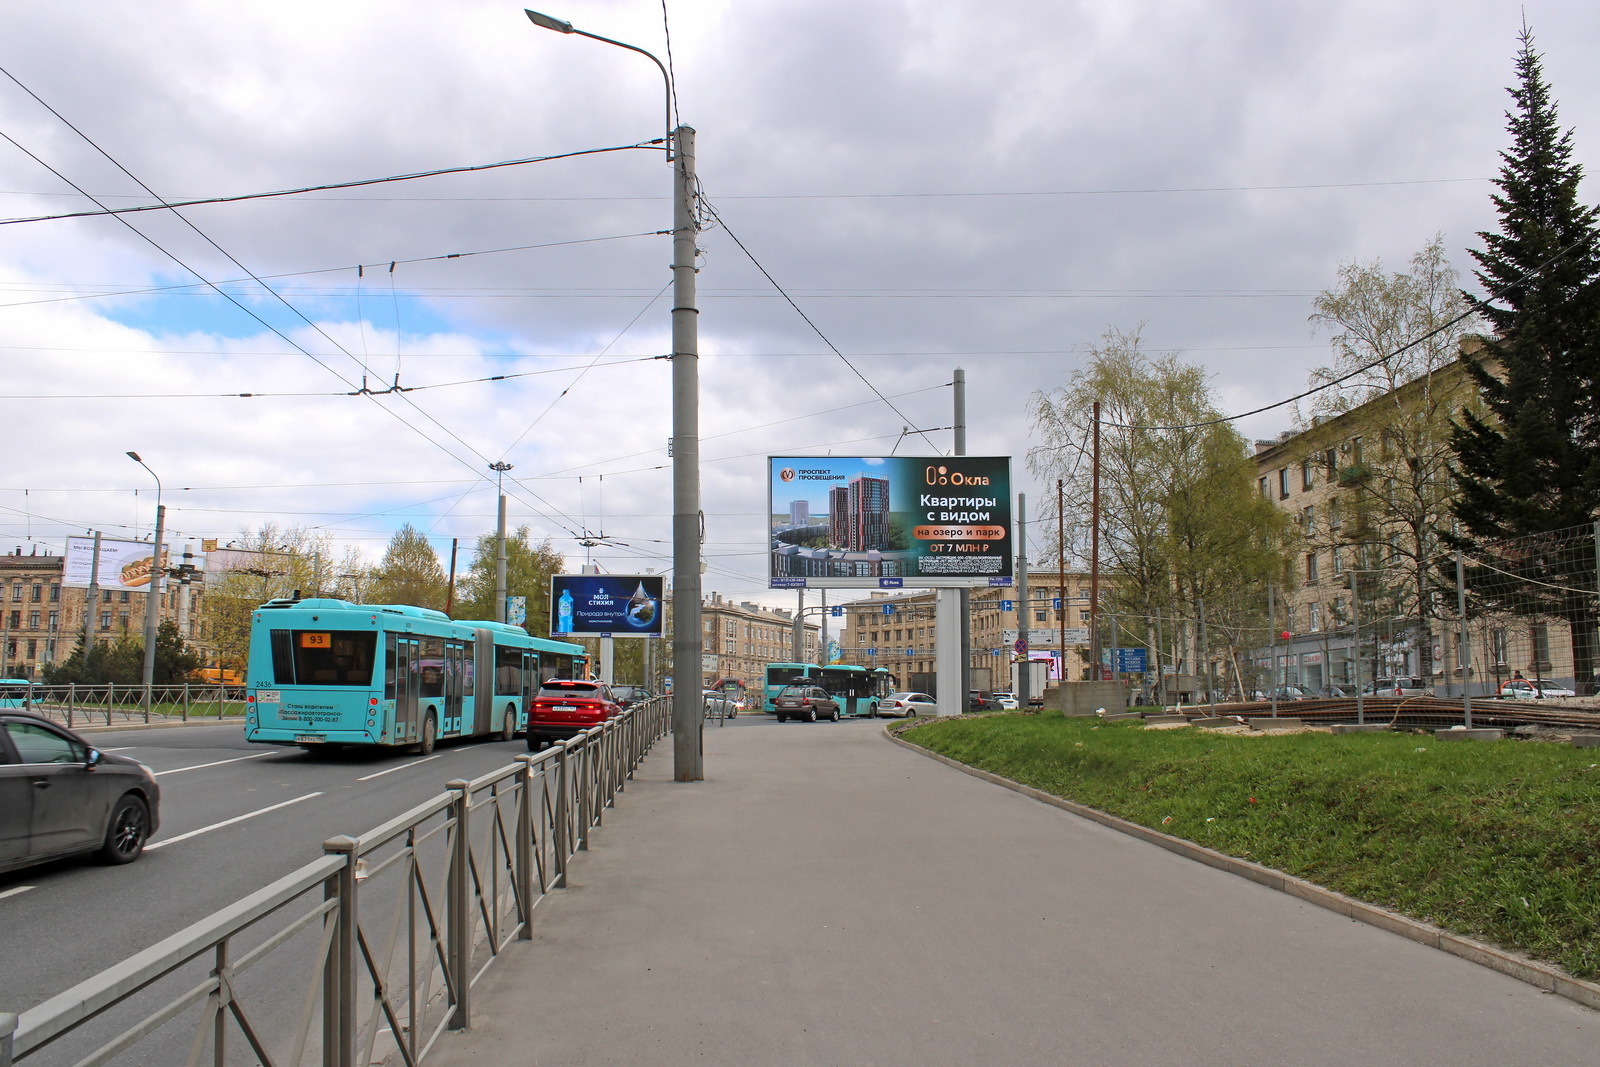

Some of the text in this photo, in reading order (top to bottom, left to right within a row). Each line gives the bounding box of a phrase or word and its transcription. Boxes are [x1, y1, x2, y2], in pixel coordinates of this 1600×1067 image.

[951, 472, 990, 486] Окла
[920, 494, 997, 510] Квартиры
[927, 511, 990, 523] с видом
[933, 529, 963, 538] озеро
[976, 529, 1001, 538] парк
[930, 544, 944, 552] ОТ
[947, 544, 954, 552] 7
[955, 544, 980, 552] МЛН
[309, 636, 323, 644] 93
